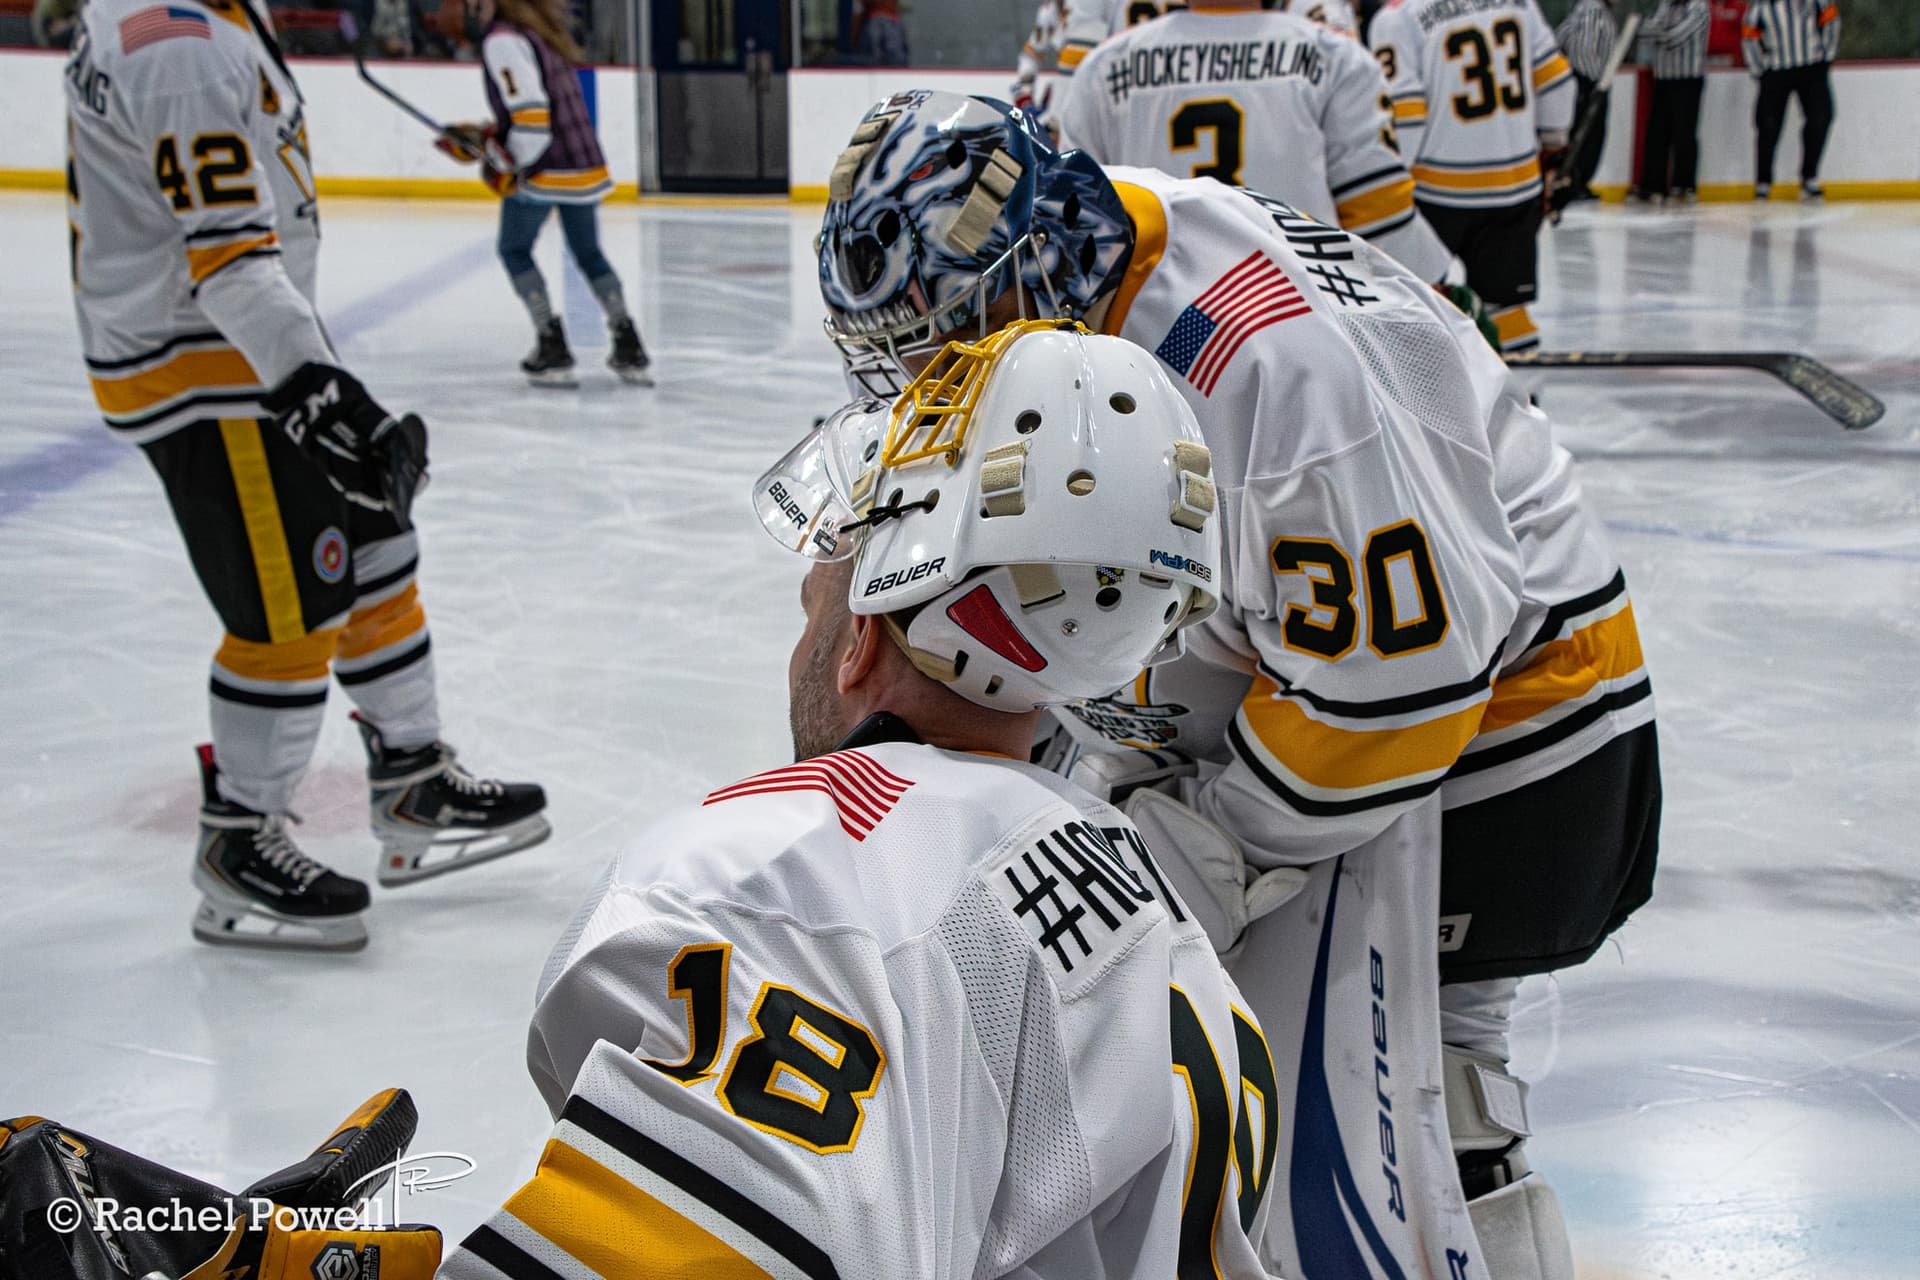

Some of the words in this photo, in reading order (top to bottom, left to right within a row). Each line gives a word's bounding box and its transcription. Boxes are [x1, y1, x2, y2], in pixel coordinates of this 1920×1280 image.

[499, 65, 519, 98] 1
[1443, 17, 1526, 125] 33
[154, 131, 260, 216] 42
[864, 556, 946, 597] BAUER
[1268, 517, 1451, 663] 30
[638, 942, 888, 1156] 18
[1370, 944, 1406, 1223] BAUER
